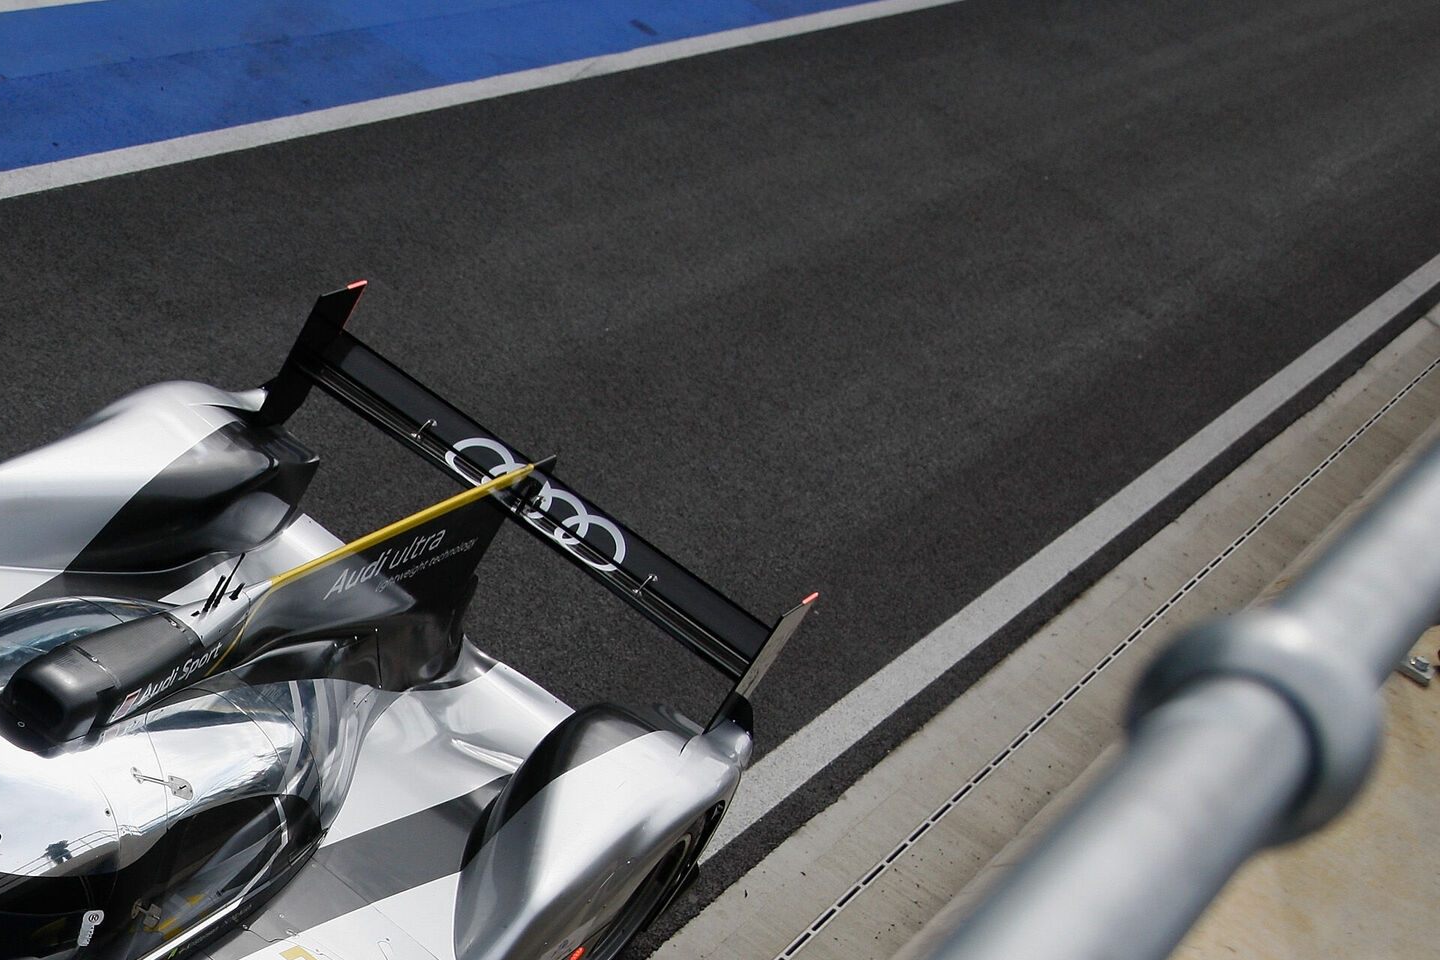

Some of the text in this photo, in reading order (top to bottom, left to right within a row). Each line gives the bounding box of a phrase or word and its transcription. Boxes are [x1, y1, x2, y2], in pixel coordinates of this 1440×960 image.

[323, 529, 447, 600] Audi ultra
[137, 641, 223, 706] Audi Sport
